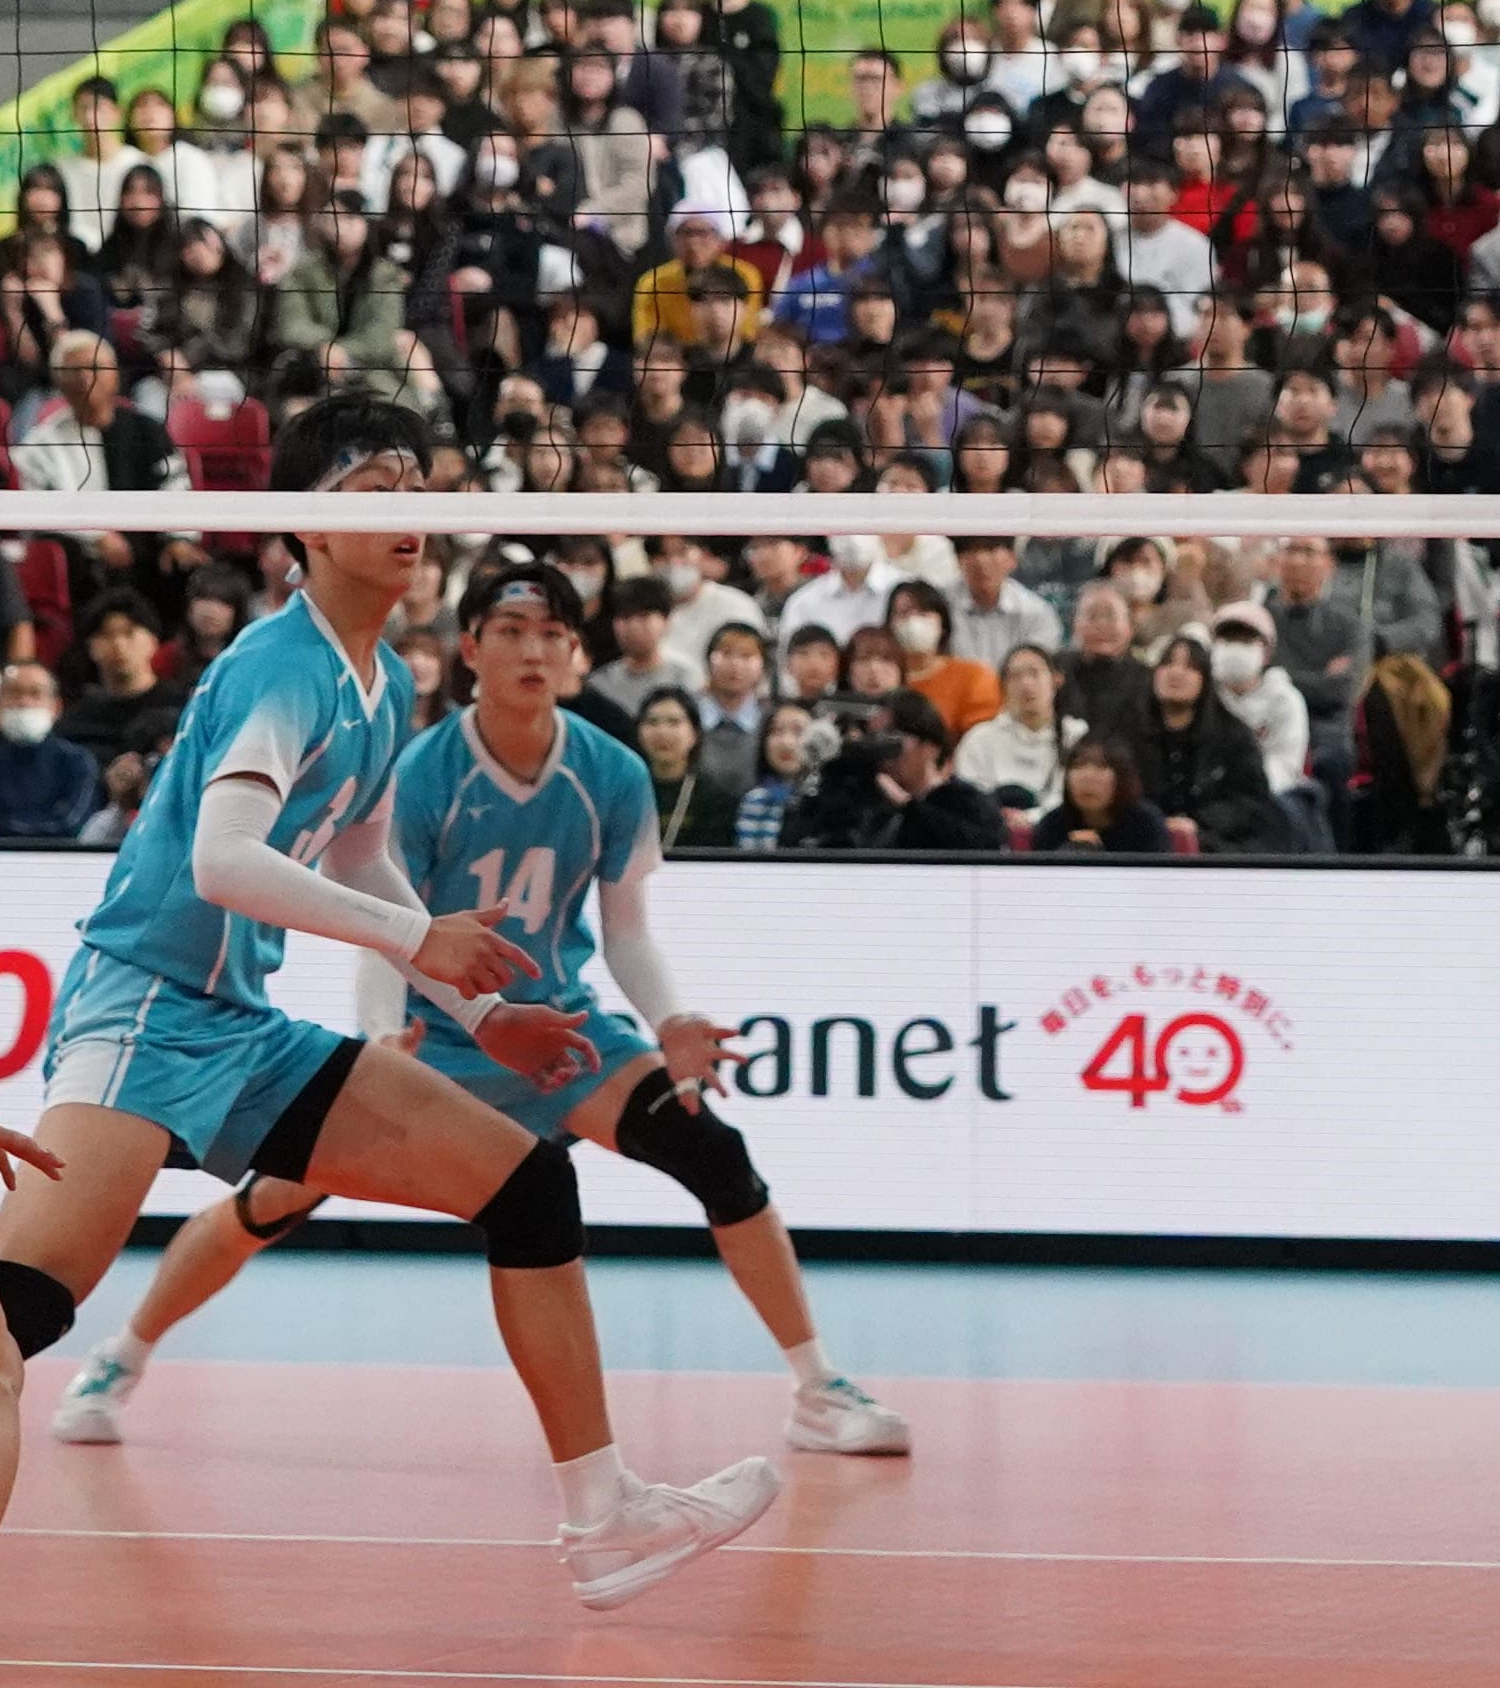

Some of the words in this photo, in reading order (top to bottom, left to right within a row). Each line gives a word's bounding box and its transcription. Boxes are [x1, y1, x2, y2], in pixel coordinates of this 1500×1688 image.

[467, 845, 556, 935] 14
[712, 1003, 1022, 1103] anet
[1081, 1014, 1245, 1108] 40
